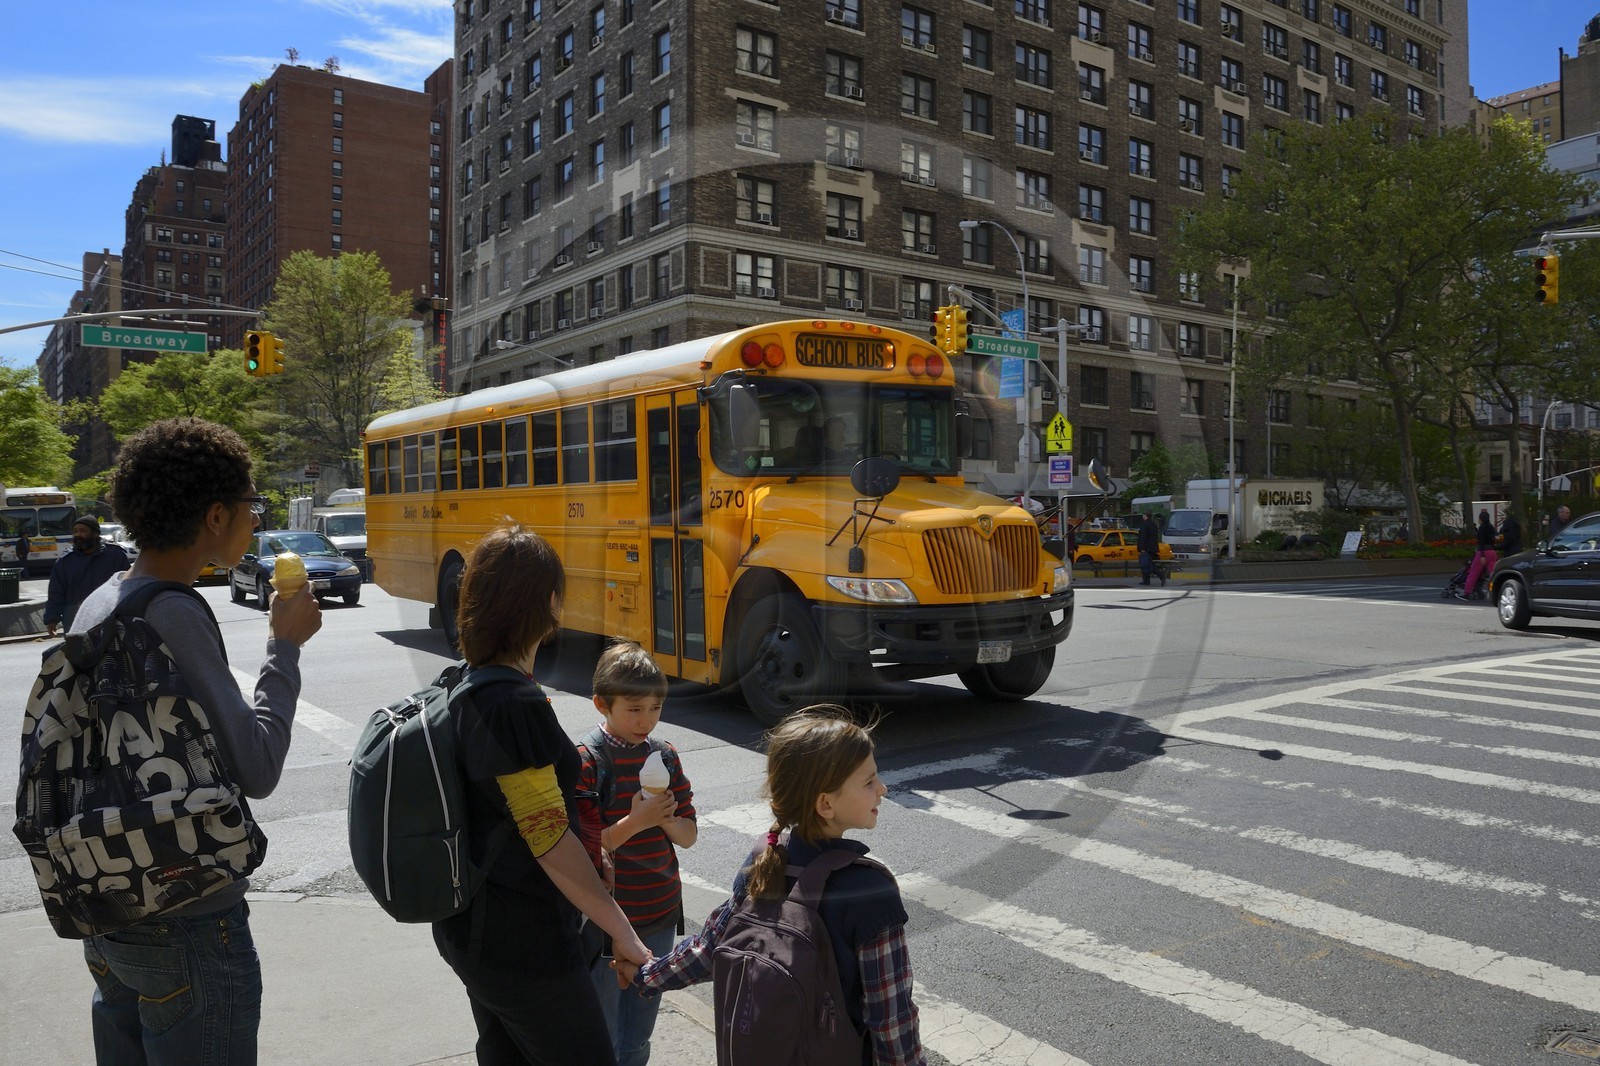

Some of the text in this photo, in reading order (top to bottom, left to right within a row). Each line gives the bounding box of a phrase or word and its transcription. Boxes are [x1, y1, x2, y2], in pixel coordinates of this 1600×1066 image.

[101, 330, 188, 350] Broadway
[977, 339, 1029, 357] Broadway
[796, 335, 885, 369] SCHOOL BUS
[709, 489, 745, 509] 2570
[567, 502, 585, 518] 2570
[156, 865, 195, 880] EASTPAK
